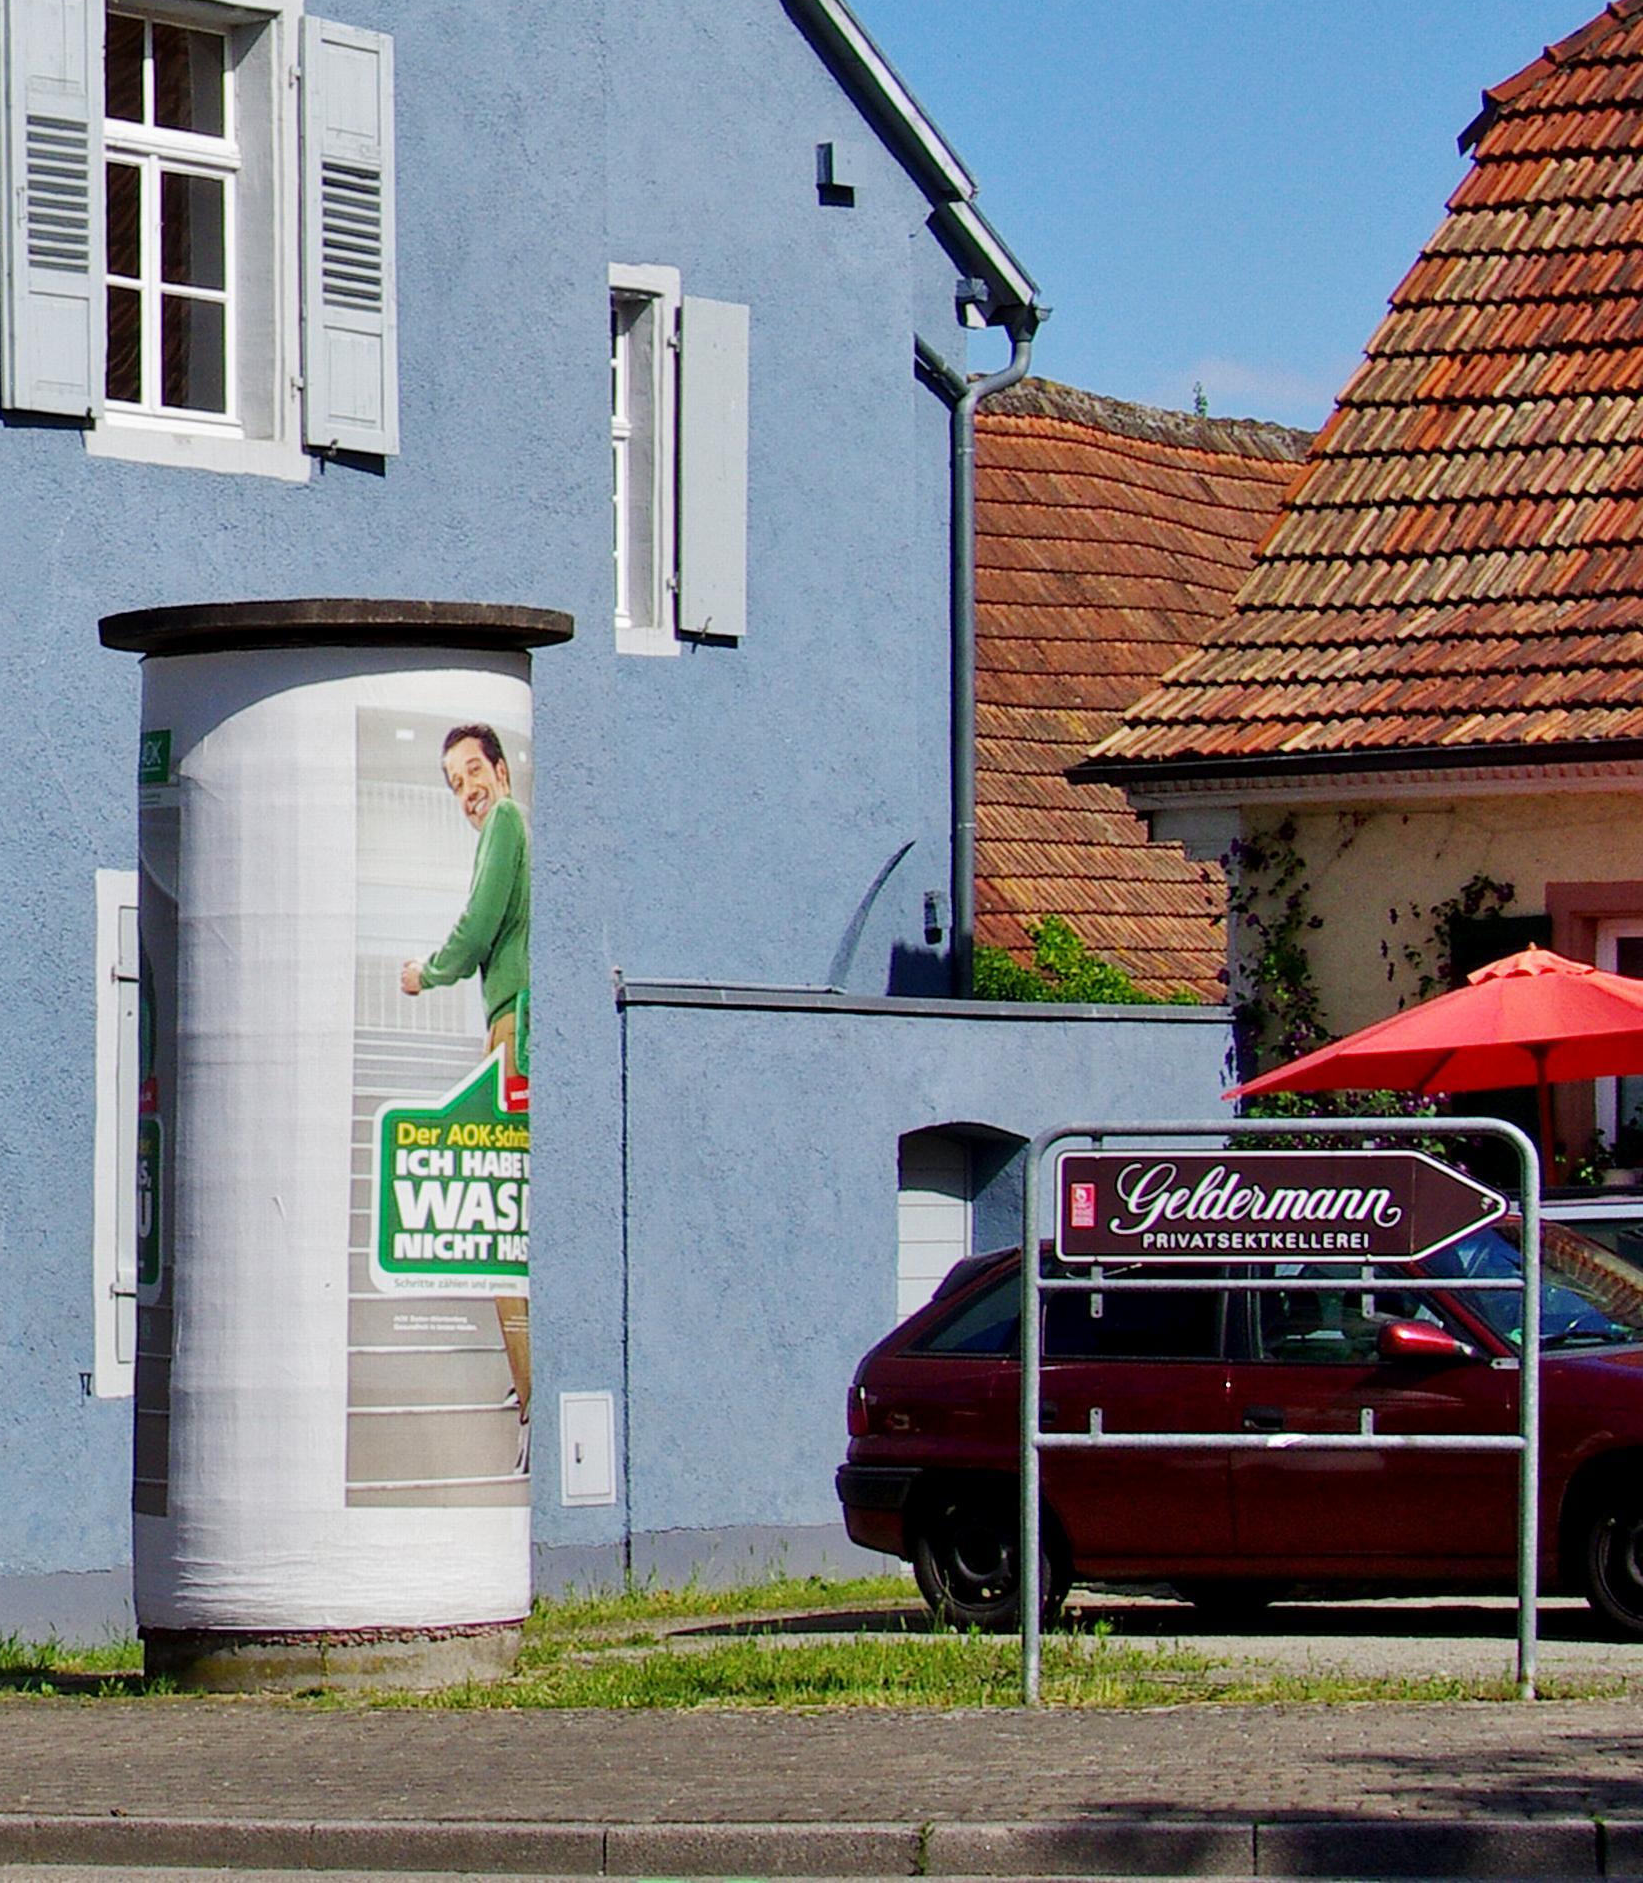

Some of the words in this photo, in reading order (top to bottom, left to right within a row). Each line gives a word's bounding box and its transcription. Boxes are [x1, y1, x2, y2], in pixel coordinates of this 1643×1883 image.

[397, 1123, 441, 1145] Der
[395, 1149, 454, 1176] ICH
[462, 1150, 522, 1178] HABE
[393, 1180, 519, 1231] WAS
[1109, 1163, 1402, 1234] Geldermann
[393, 1233, 493, 1260] NICHT
[1143, 1233, 1369, 1249] PRIVATSEKTKELLEREI
